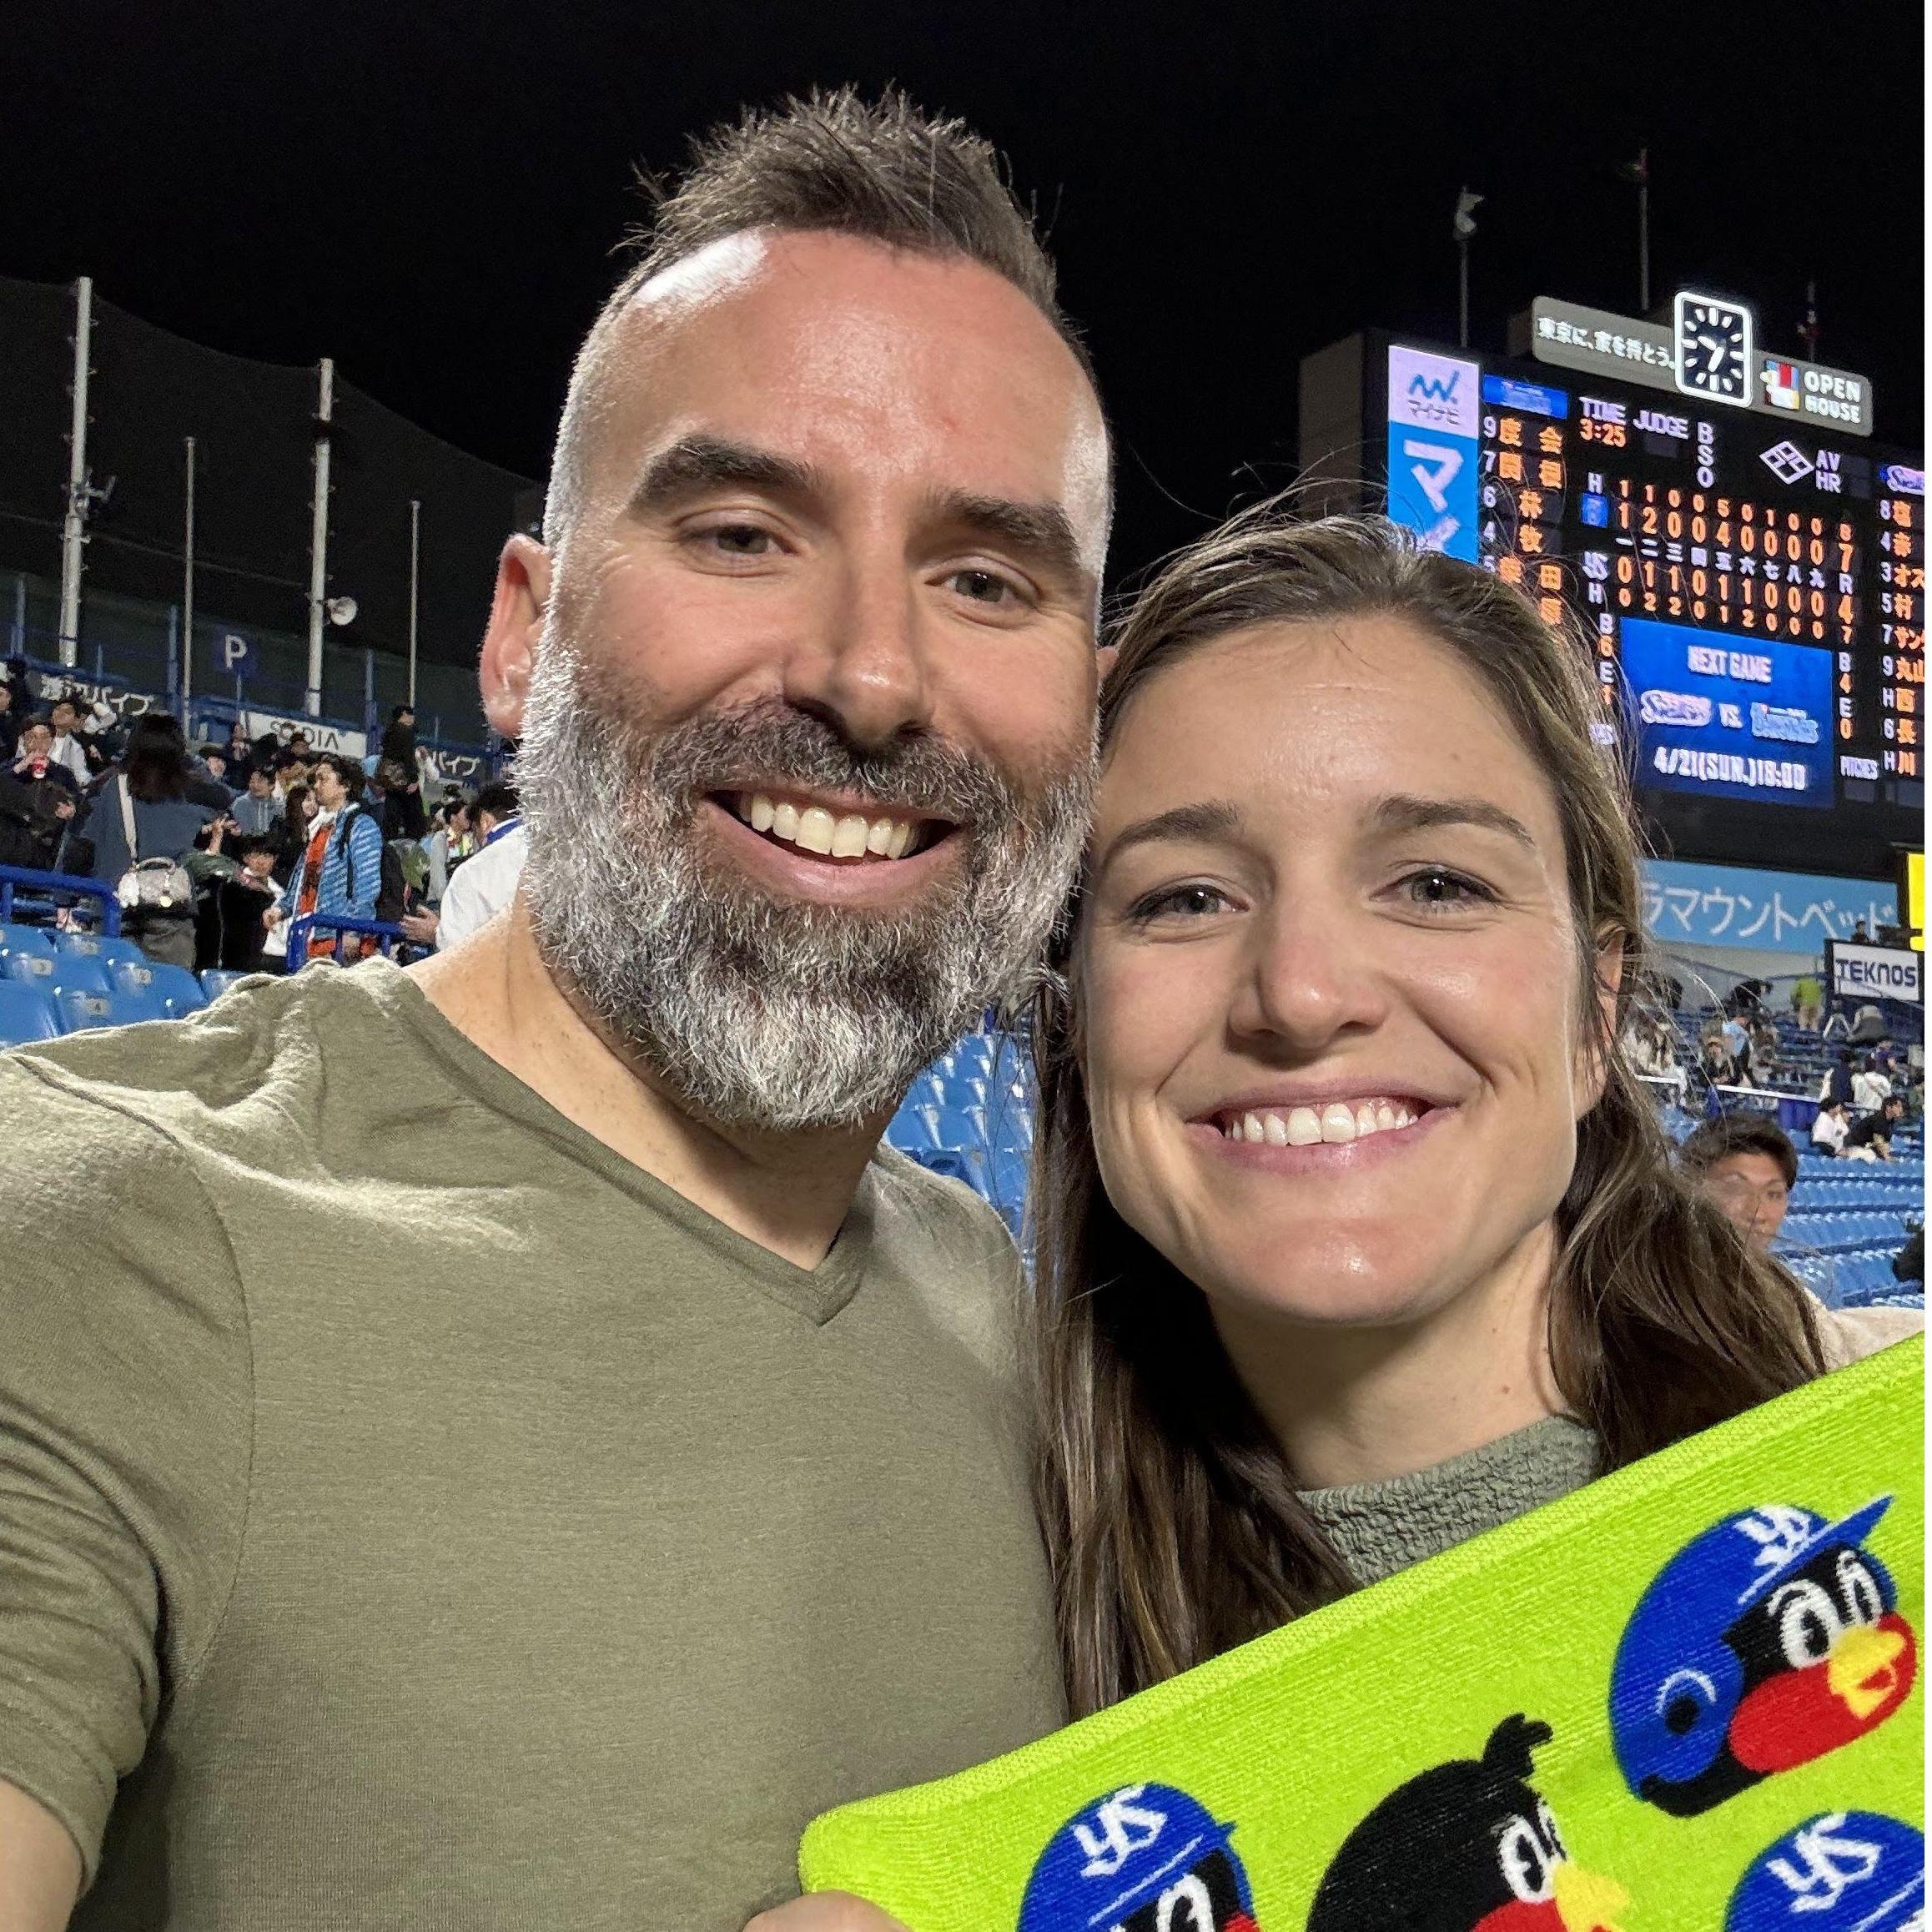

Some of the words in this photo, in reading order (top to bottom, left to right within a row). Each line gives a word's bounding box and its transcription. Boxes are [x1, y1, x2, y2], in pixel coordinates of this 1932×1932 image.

[1804, 370, 1861, 403] OPEN
[1579, 395, 1627, 427] TIME
[1633, 410, 1689, 440] JUDGE
[1698, 421, 1714, 445] B
[1804, 393, 1861, 424] HOUSE
[1483, 416, 1497, 439] 9
[1580, 417, 1628, 448] 3:25
[1483, 450, 1497, 473] 7
[1698, 445, 1714, 467] S
[1816, 450, 1841, 472] AV
[1816, 470, 1842, 493] HR
[1483, 485, 1497, 509] 6
[1587, 471, 1602, 493] H
[1619, 479, 1630, 499] 1
[1644, 484, 1654, 503] 1
[1668, 489, 1681, 509] 0
[1693, 493, 1705, 513] 0
[1741, 503, 1753, 523] 0
[1766, 508, 1775, 527] 1
[1787, 512, 1800, 531] 0
[1810, 516, 1823, 536] 0
[1879, 498, 1892, 521] 8
[1618, 502, 1631, 530] 1
[1642, 506, 1658, 535] 2
[1667, 511, 1683, 539] 0
[1692, 516, 1708, 544] 0
[1717, 521, 1732, 548] 4
[1738, 525, 1754, 553] 0
[1763, 530, 1779, 557] 0
[1785, 534, 1801, 562] 0
[1809, 538, 1824, 566] 0
[1838, 543, 1854, 572] 7
[1640, 538, 1659, 557] 二
[1666, 541, 1683, 563] 三
[1714, 551, 1733, 572] 五
[1739, 556, 1756, 577] 六
[1762, 560, 1779, 581] 七
[1787, 564, 1802, 586] 八
[1838, 571, 1853, 595] R
[1880, 561, 1893, 584] 3
[1617, 555, 1633, 585] 0
[1643, 560, 1655, 588] 1
[1668, 565, 1680, 593] 1
[1691, 569, 1708, 597] 0
[1718, 574, 1729, 601] 1
[1741, 577, 1753, 605] 1
[1763, 581, 1779, 610] 0
[1787, 586, 1802, 614] 0
[1809, 589, 1825, 618] 0
[1838, 595, 1854, 624] 4
[1588, 581, 1602, 605] H
[1618, 586, 1632, 608] 0
[1643, 591, 1658, 612] 2
[1668, 596, 1682, 616] 2
[1693, 599, 1706, 620] 0
[1718, 604, 1728, 625] 1
[1740, 607, 1754, 629] 2
[1764, 611, 1778, 633] 0
[1788, 616, 1801, 636] 0
[1811, 620, 1824, 641] 0
[1880, 591, 1893, 615] 5
[1599, 613, 1616, 636] B
[1881, 622, 1893, 646] 7
[224, 633, 249, 669] P
[1600, 635, 1614, 657] 6
[1599, 661, 1616, 684] E
[1687, 645, 1728, 678] NEXT
[1728, 651, 1774, 684] GAME
[1838, 651, 1851, 673] B
[1882, 654, 1894, 677] 9
[1839, 673, 1850, 695] 4
[1839, 697, 1852, 719] E
[1882, 687, 1894, 710] H
[1839, 717, 1852, 741] 0
[1883, 717, 1894, 740] 6
[1883, 750, 1895, 772] H
[1834, 958, 1918, 989] TEKNOS
